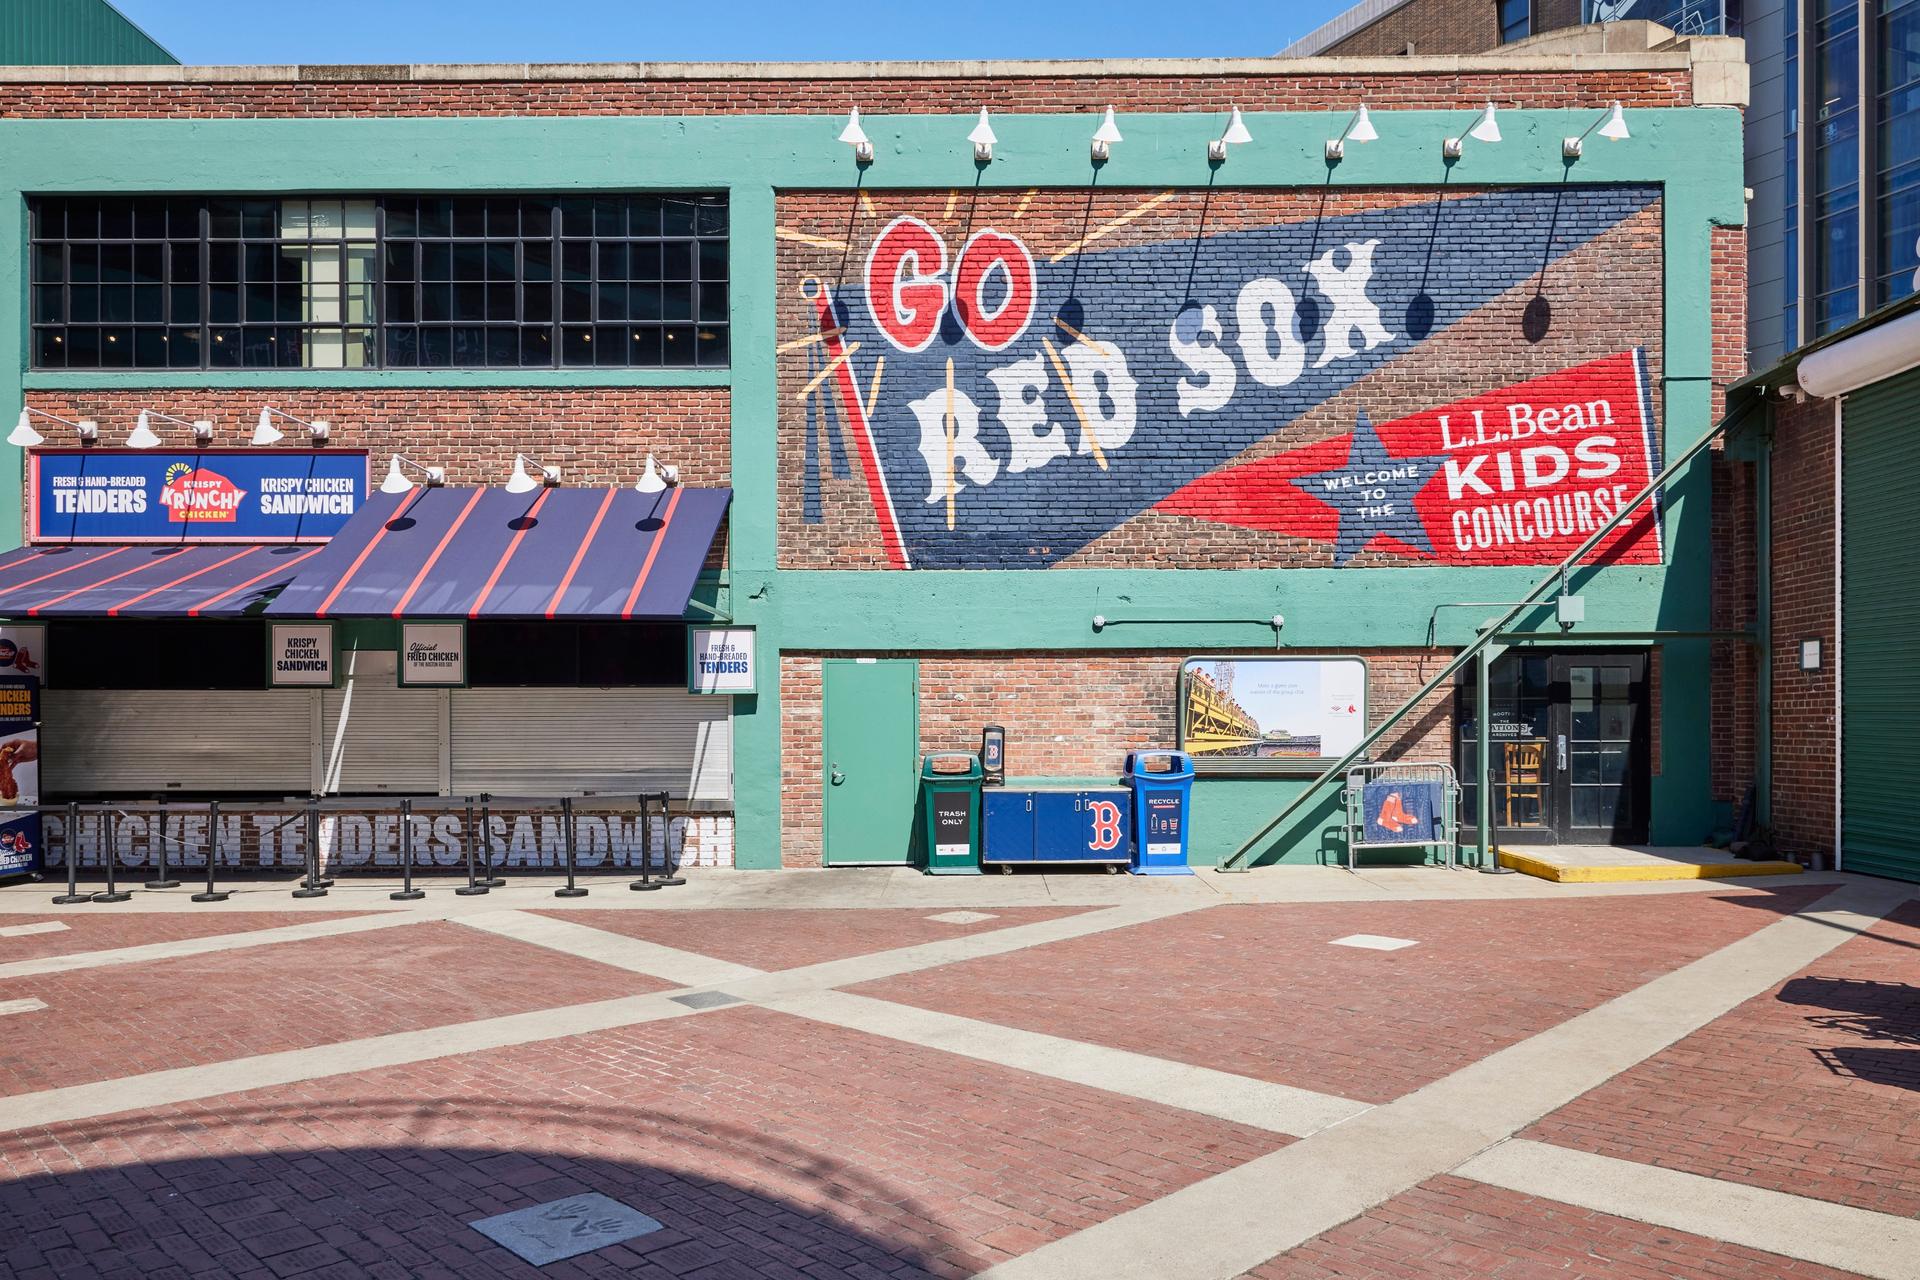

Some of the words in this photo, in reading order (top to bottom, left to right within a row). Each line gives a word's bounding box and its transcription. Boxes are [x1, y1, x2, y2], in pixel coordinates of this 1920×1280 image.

[864, 215, 1037, 353] GO
[906, 340, 1140, 504] RED
[1169, 239, 1397, 418] SOX
[1438, 399, 1615, 450] L.L.Bean
[1444, 435, 1621, 500] KIDS
[53, 476, 77, 487] FRESH
[78, 476, 84, 487] &
[85, 476, 146, 487] HAND-BREADED
[183, 480, 222, 489] KRISPY
[1323, 465, 1419, 490] WELCOME
[261, 478, 303, 493] KRISPY
[305, 478, 354, 493] CHICKEN
[53, 489, 147, 513] TENDERS
[161, 486, 246, 510] KRUNCHY
[1360, 488, 1386, 502] TO
[260, 494, 354, 514] SANDWICH
[1356, 503, 1395, 519] THE
[1452, 484, 1633, 551] CONCOURSE
[287, 638, 317, 648] KRISPY
[410, 642, 438, 653] Official
[711, 644, 730, 652] FRESH
[731, 644, 736, 652] &
[285, 649, 319, 659] CHICKEN
[407, 652, 427, 661] FRIED
[428, 652, 459, 661] CHICKEN
[700, 652, 748, 661] HAND-BREADED
[277, 660, 328, 671] SANDWICH
[699, 661, 748, 674] TENDERS
[0, 703, 31, 715] NDERS
[1088, 800, 1123, 850] B
[478, 815, 734, 867] SANDWICH
